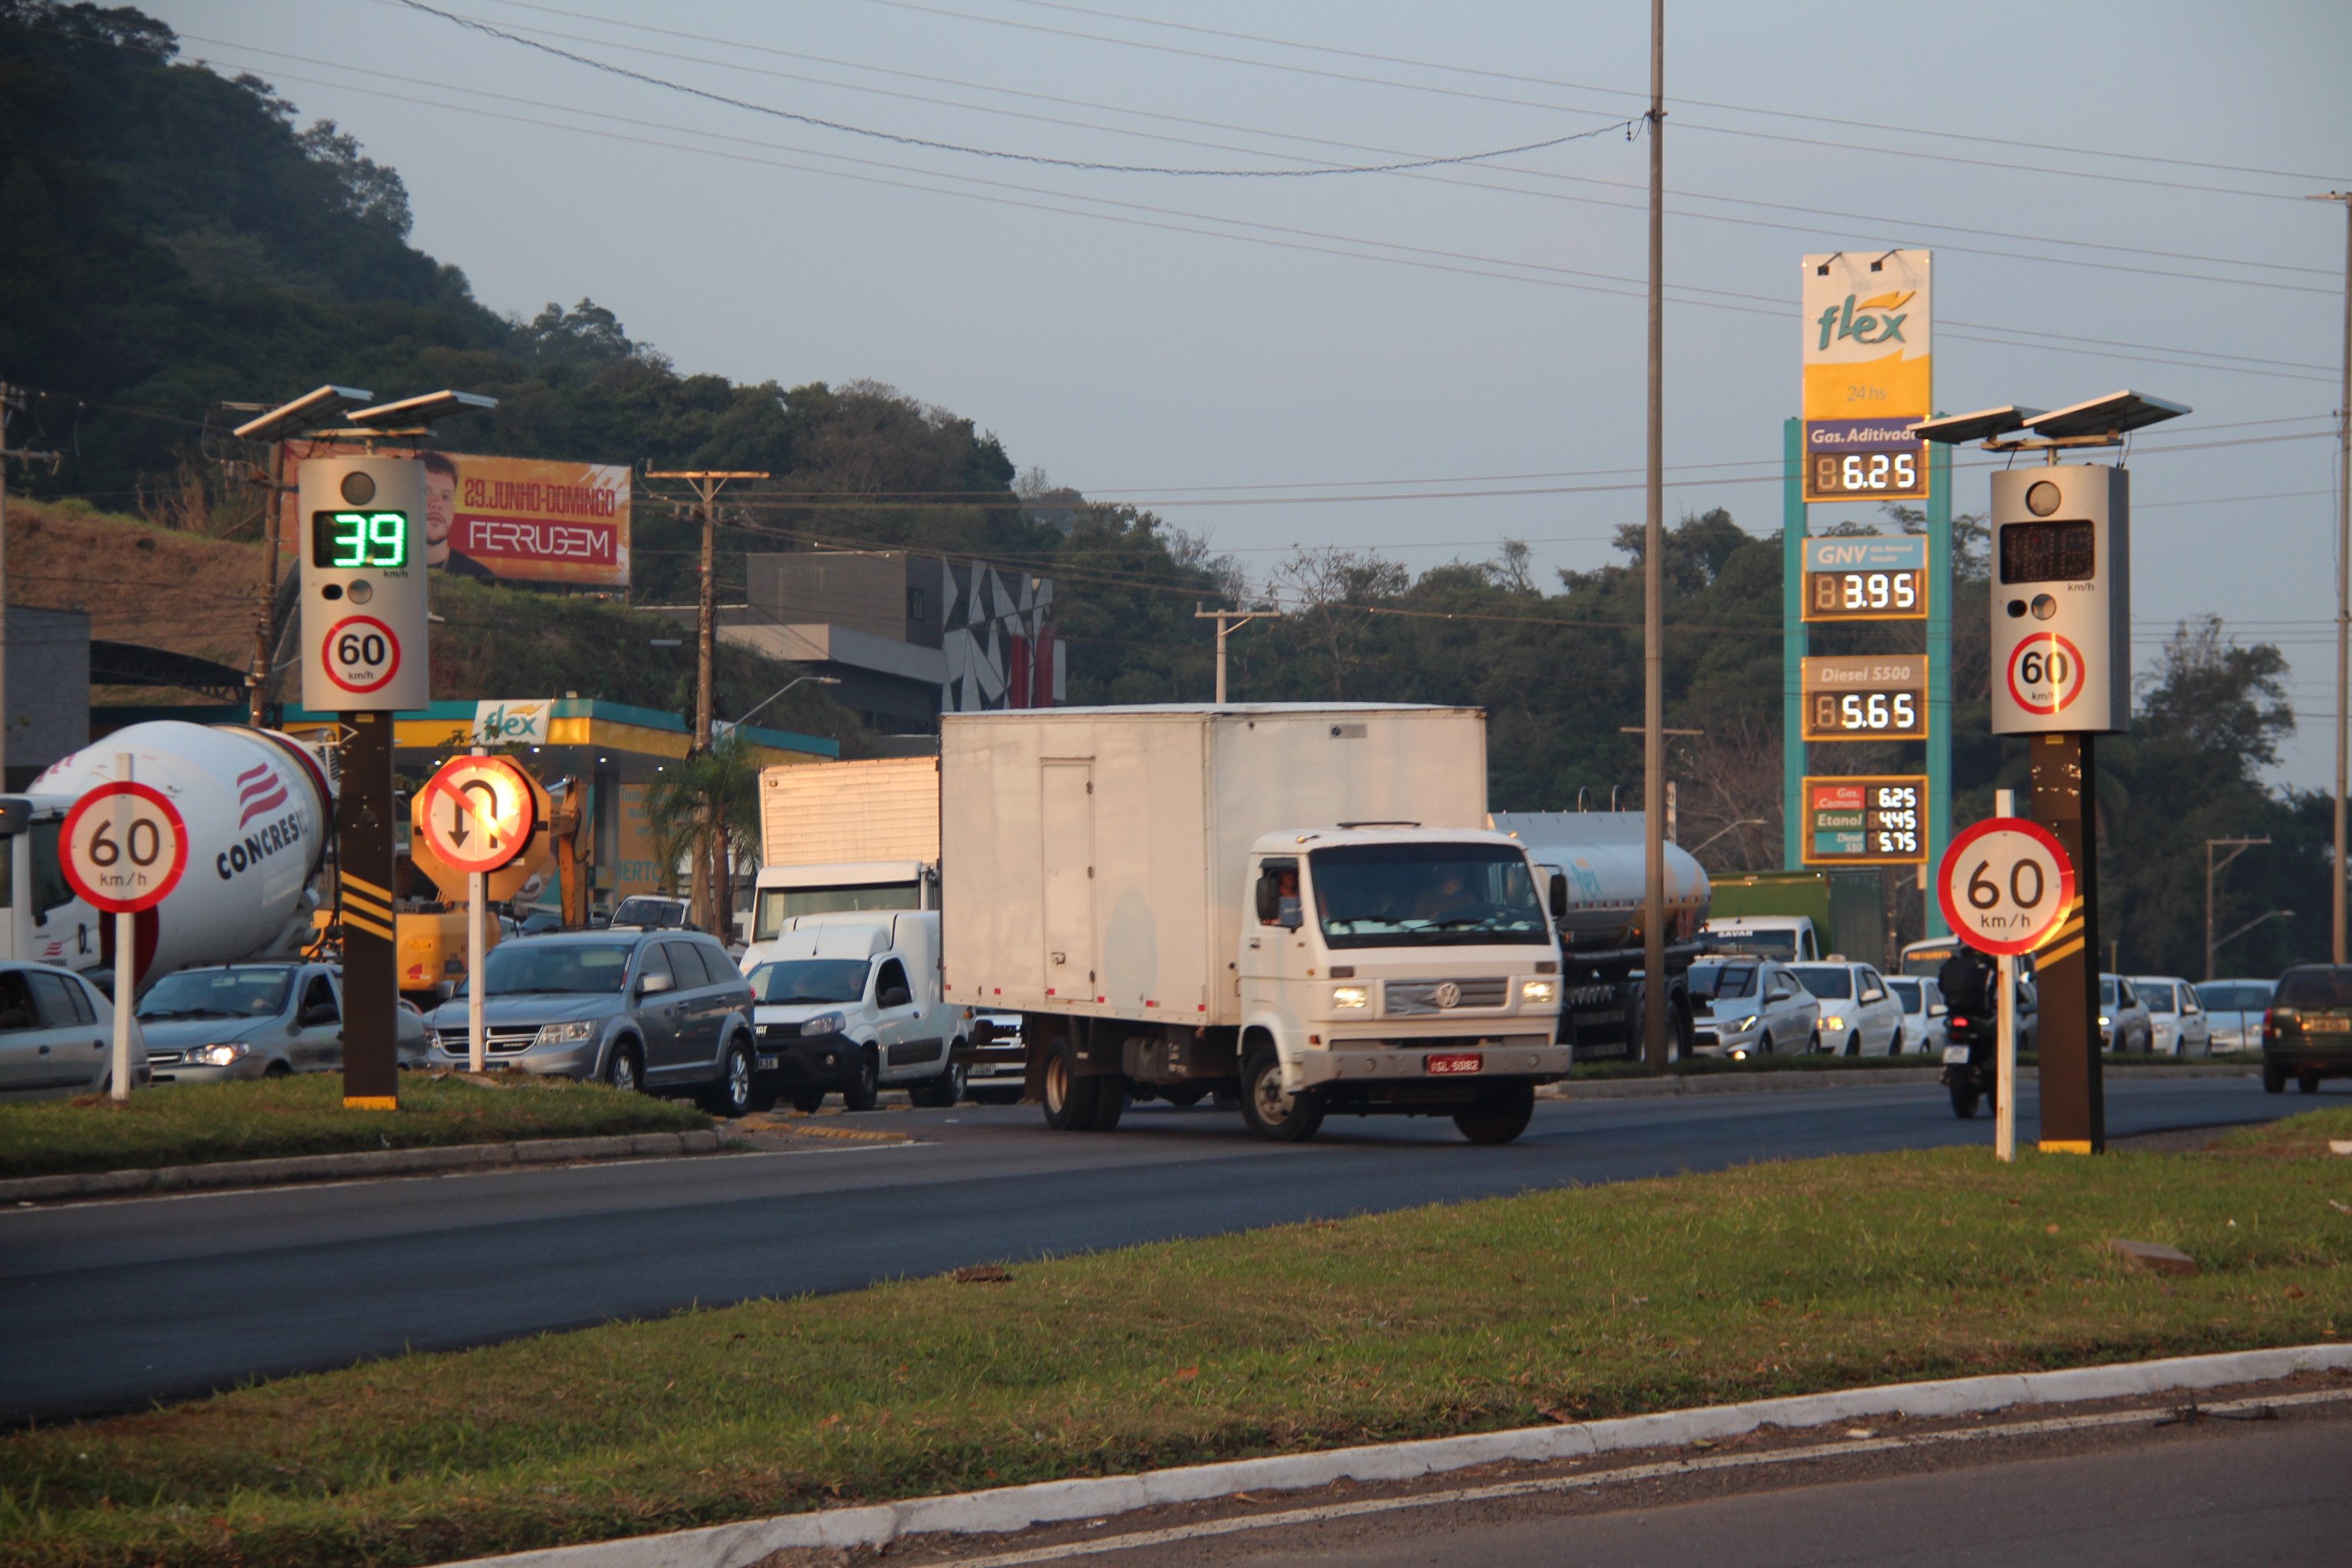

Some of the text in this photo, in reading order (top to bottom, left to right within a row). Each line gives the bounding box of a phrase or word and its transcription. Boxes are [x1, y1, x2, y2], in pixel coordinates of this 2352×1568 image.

[1817, 294, 1908, 350] flex
[1846, 384, 1886, 402] 24 hs
[1811, 429, 1845, 443] Gas.
[1842, 453, 1915, 490] 6.25
[334, 513, 404, 567] 39
[469, 520, 609, 558] FERRUGEM
[1817, 544, 1868, 564] GNV
[384, 569, 409, 578] km/h
[1845, 573, 1915, 609] 3.95
[2067, 583, 2095, 592] km/h
[337, 633, 385, 666] 60
[348, 670, 374, 680] km/h
[1821, 666, 1911, 682] Diesel S500
[2021, 651, 2068, 684] 60
[1842, 693, 1915, 729] 5.65
[483, 703, 537, 742] flex
[1836, 787, 1860, 798] Gas.
[1819, 798, 1860, 808] Comum
[1817, 813, 1863, 827] Etanol
[88, 818, 160, 867] 60
[99, 872, 147, 886] km/h
[1967, 858, 2045, 909] 60
[1981, 913, 2031, 928] km/h
[1717, 930, 1753, 938] SAVAR
